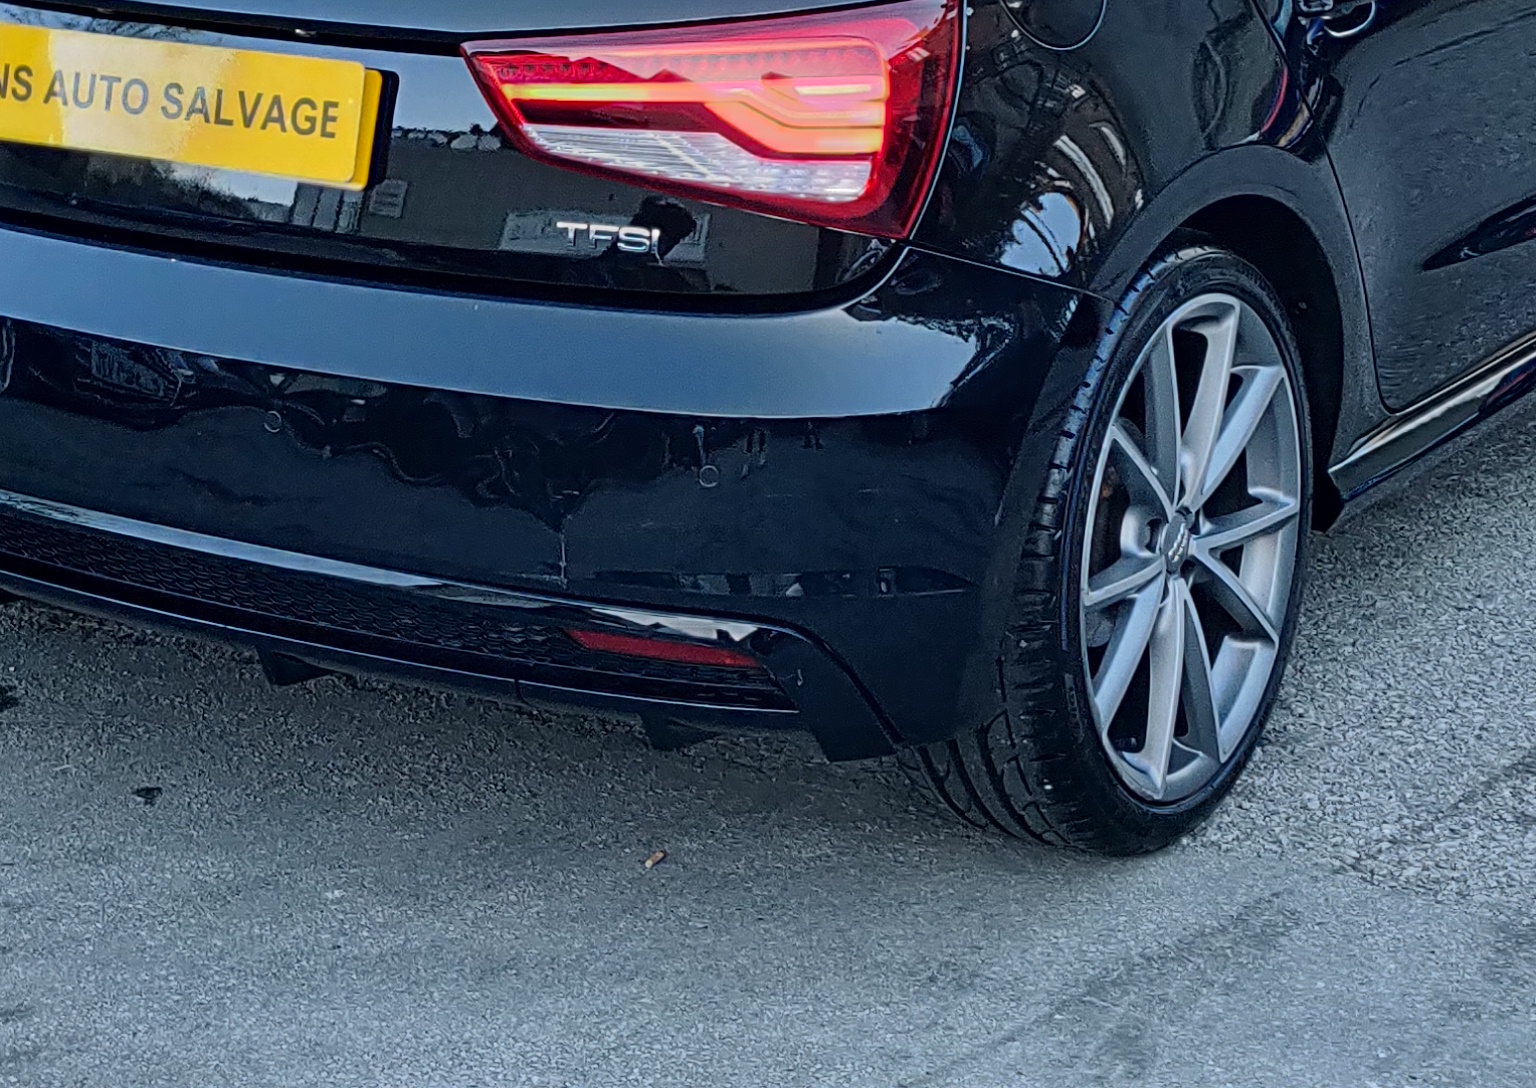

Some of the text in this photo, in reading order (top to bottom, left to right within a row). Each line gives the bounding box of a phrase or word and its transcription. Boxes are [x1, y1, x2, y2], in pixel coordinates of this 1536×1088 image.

[43, 69, 149, 115] AUTO
[160, 82, 340, 139] SALVAGE
[556, 221, 661, 253] TFSI
